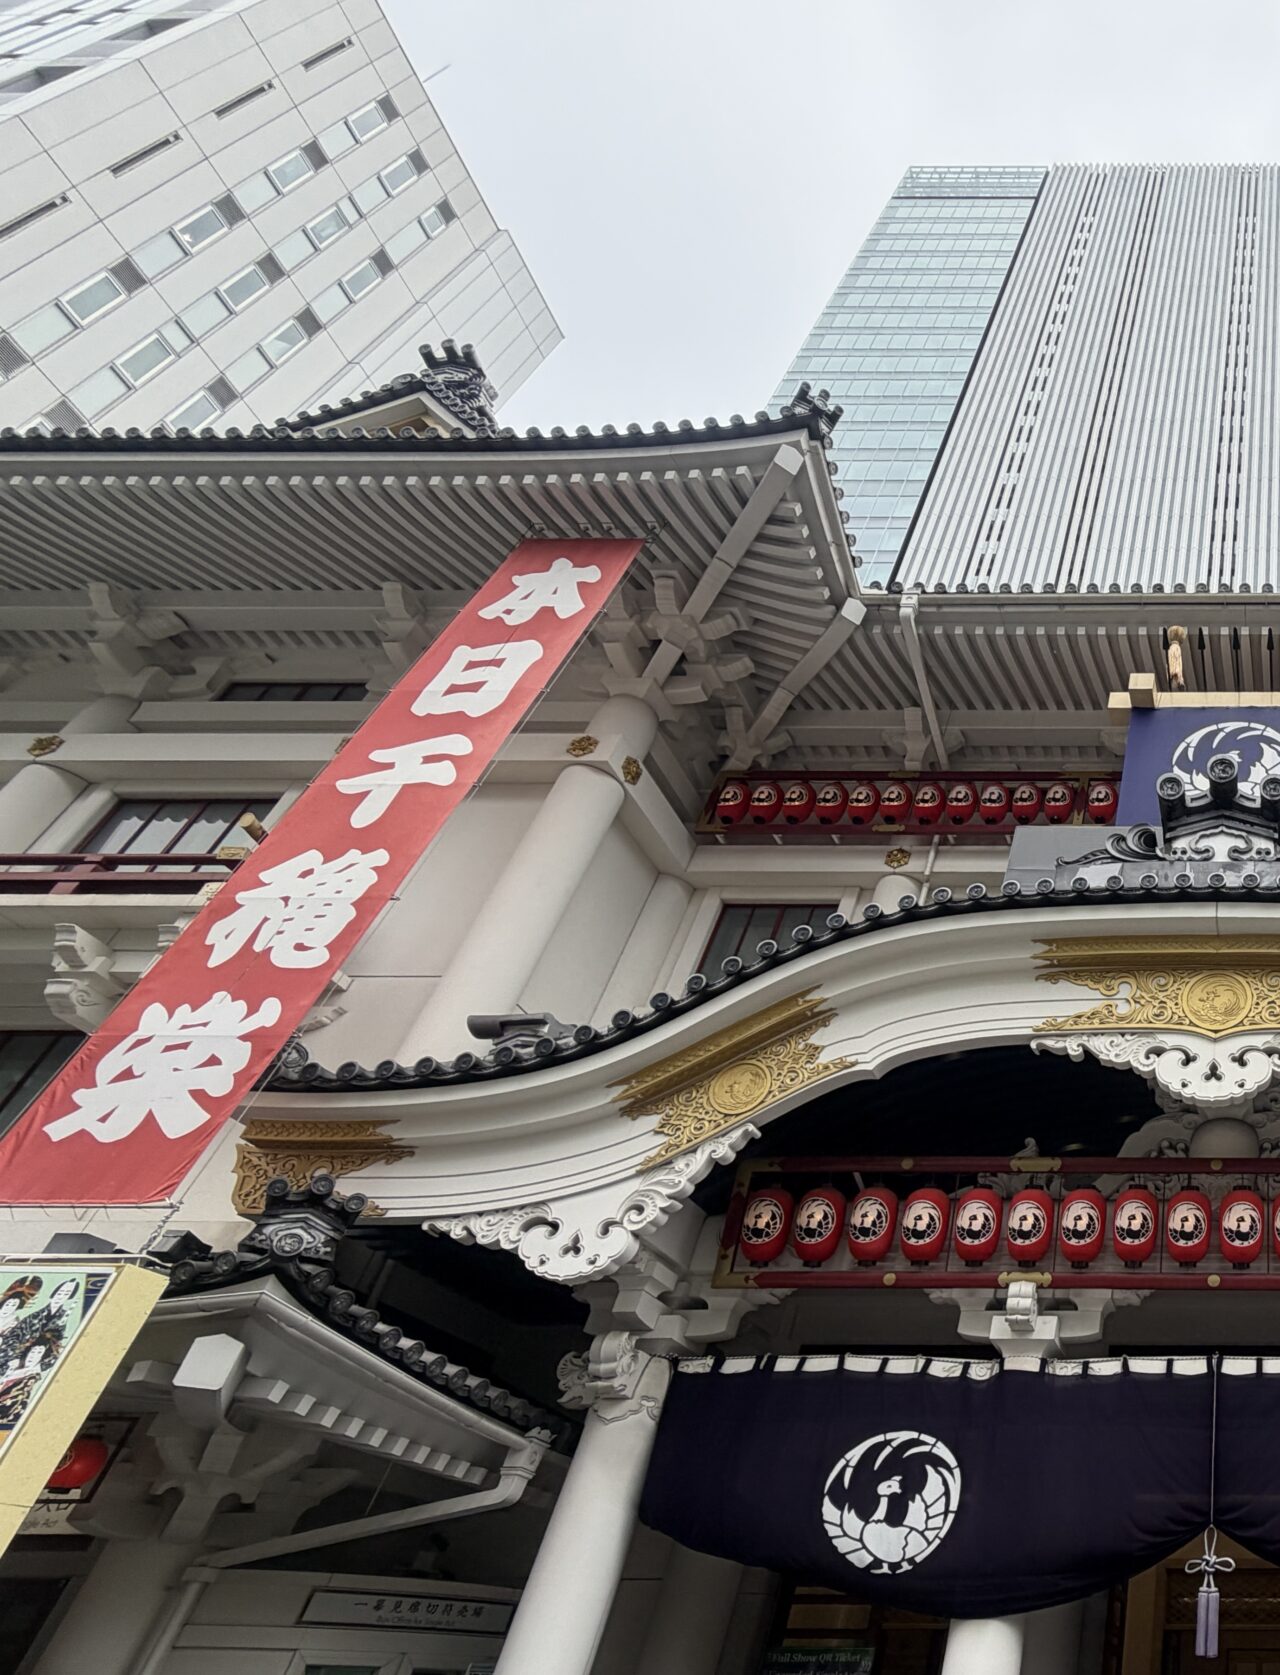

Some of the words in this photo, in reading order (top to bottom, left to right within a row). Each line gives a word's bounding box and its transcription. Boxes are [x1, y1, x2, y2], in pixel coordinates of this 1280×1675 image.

[43, 556, 602, 1143] 本日千穐楽
[772, 1653, 791, 1663] Full
[792, 1653, 817, 1663] Show
[819, 1653, 833, 1664] QR
[835, 1652, 861, 1663] Ticket
